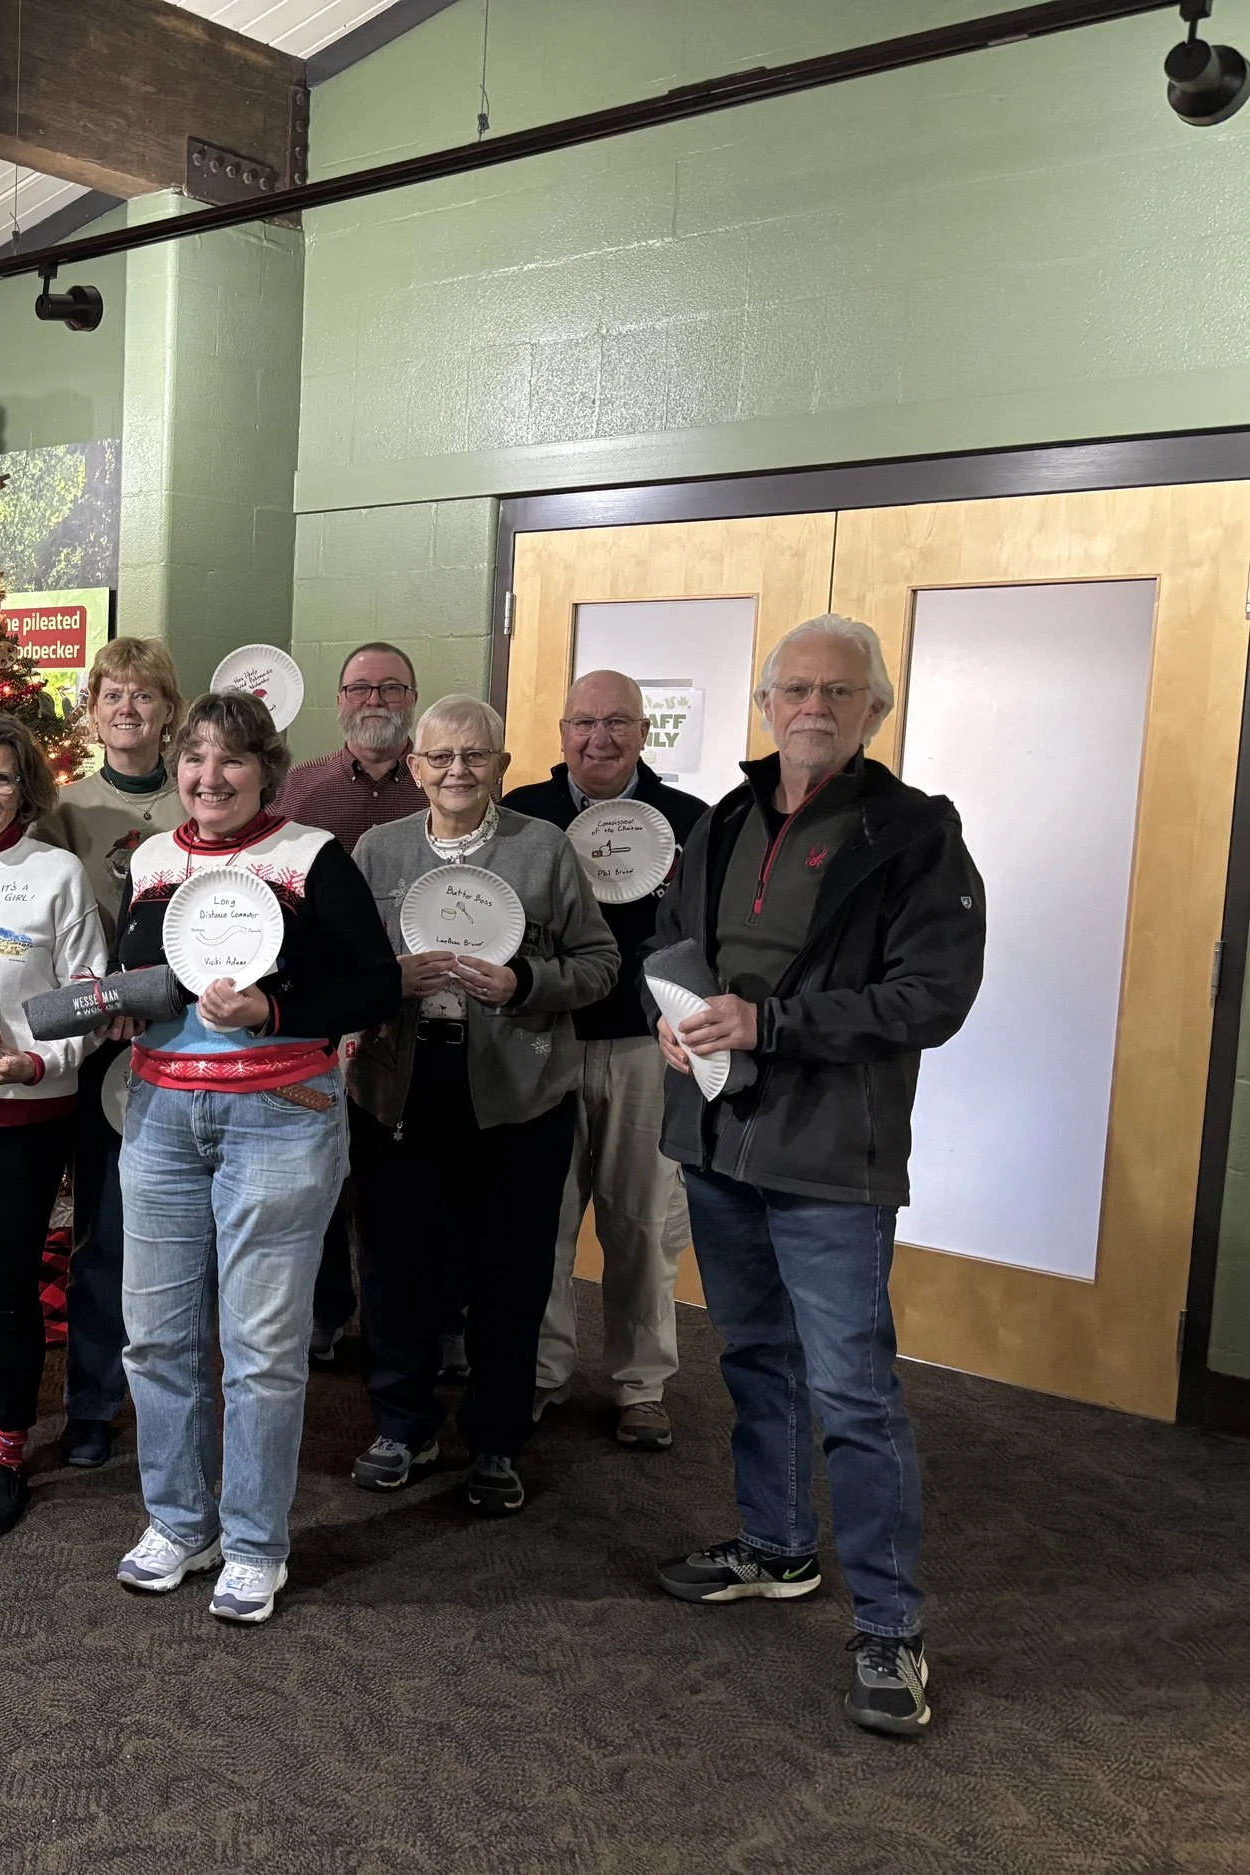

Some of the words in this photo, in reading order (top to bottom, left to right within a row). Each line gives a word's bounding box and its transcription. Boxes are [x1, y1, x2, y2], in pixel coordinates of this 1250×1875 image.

[23, 611, 80, 636] pileated
[649, 713, 687, 729] AFF
[1, 882, 17, 892] IT'S
[214, 896, 236, 907] Long
[446, 886, 472, 899] Butter
[474, 894, 492, 907] Boss
[200, 910, 227, 919] Distance
[205, 957, 222, 965] Vicki
[72, 989, 120, 1010] WESSEMAN
